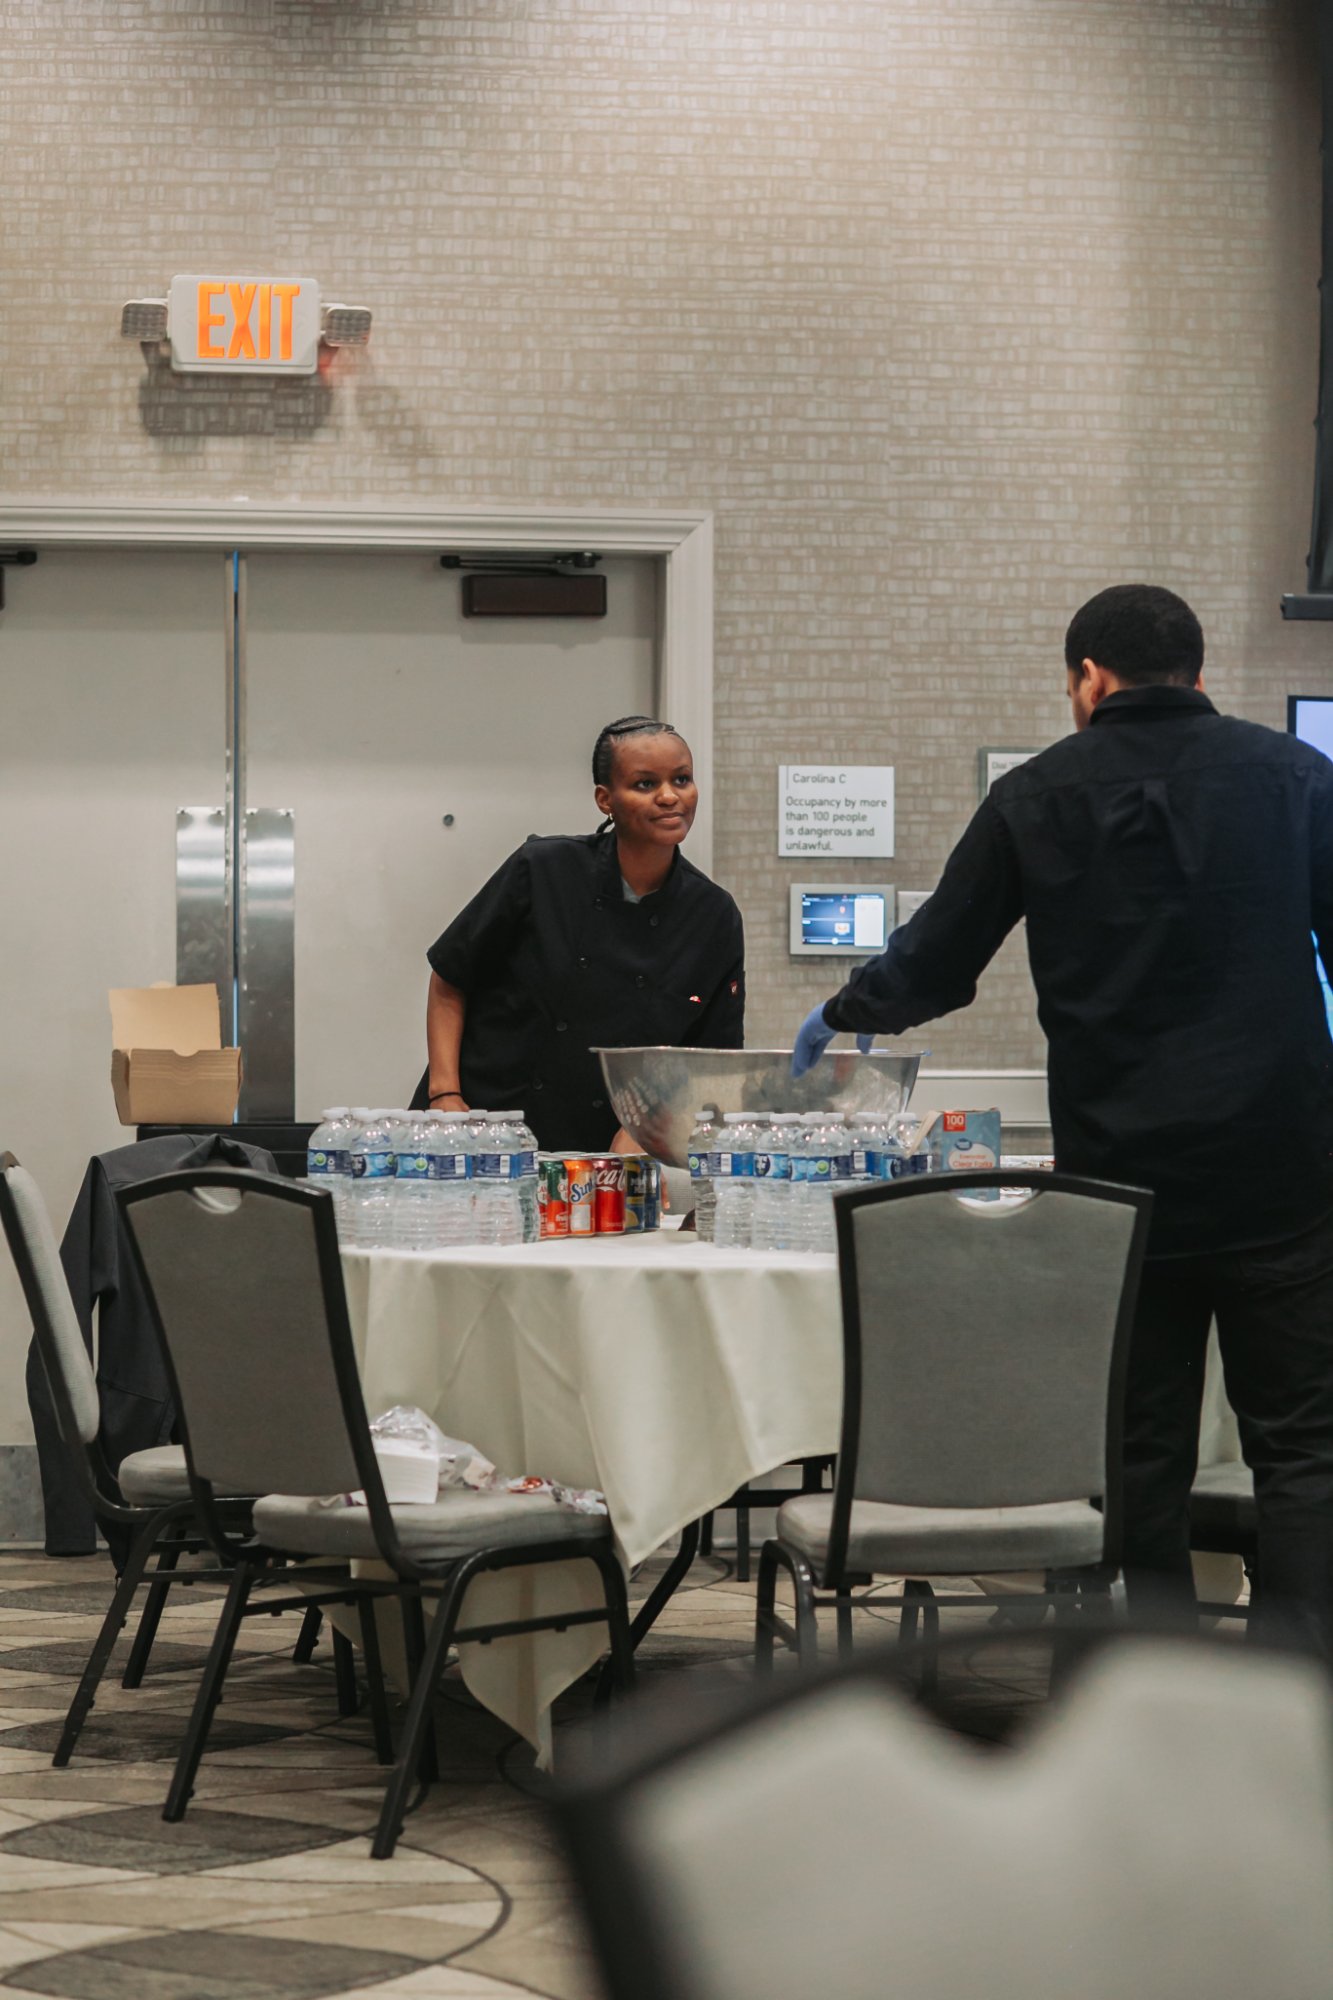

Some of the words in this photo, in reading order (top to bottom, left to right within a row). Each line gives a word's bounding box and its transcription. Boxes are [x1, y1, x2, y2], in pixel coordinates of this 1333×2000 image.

[198, 282, 300, 360] EXIT
[792, 773, 836, 784] Carolina
[838, 773, 847, 784] C
[786, 795, 841, 809] Occupancy
[844, 797, 856, 809] by
[859, 799, 888, 808] more
[786, 811, 809, 821] than
[812, 811, 830, 821] 100
[832, 812, 868, 824] people
[786, 825, 795, 836] is
[797, 826, 853, 839] dangerous
[856, 827, 875, 837] and
[786, 840, 833, 851] unlawful.
[946, 1115, 964, 1126] 100
